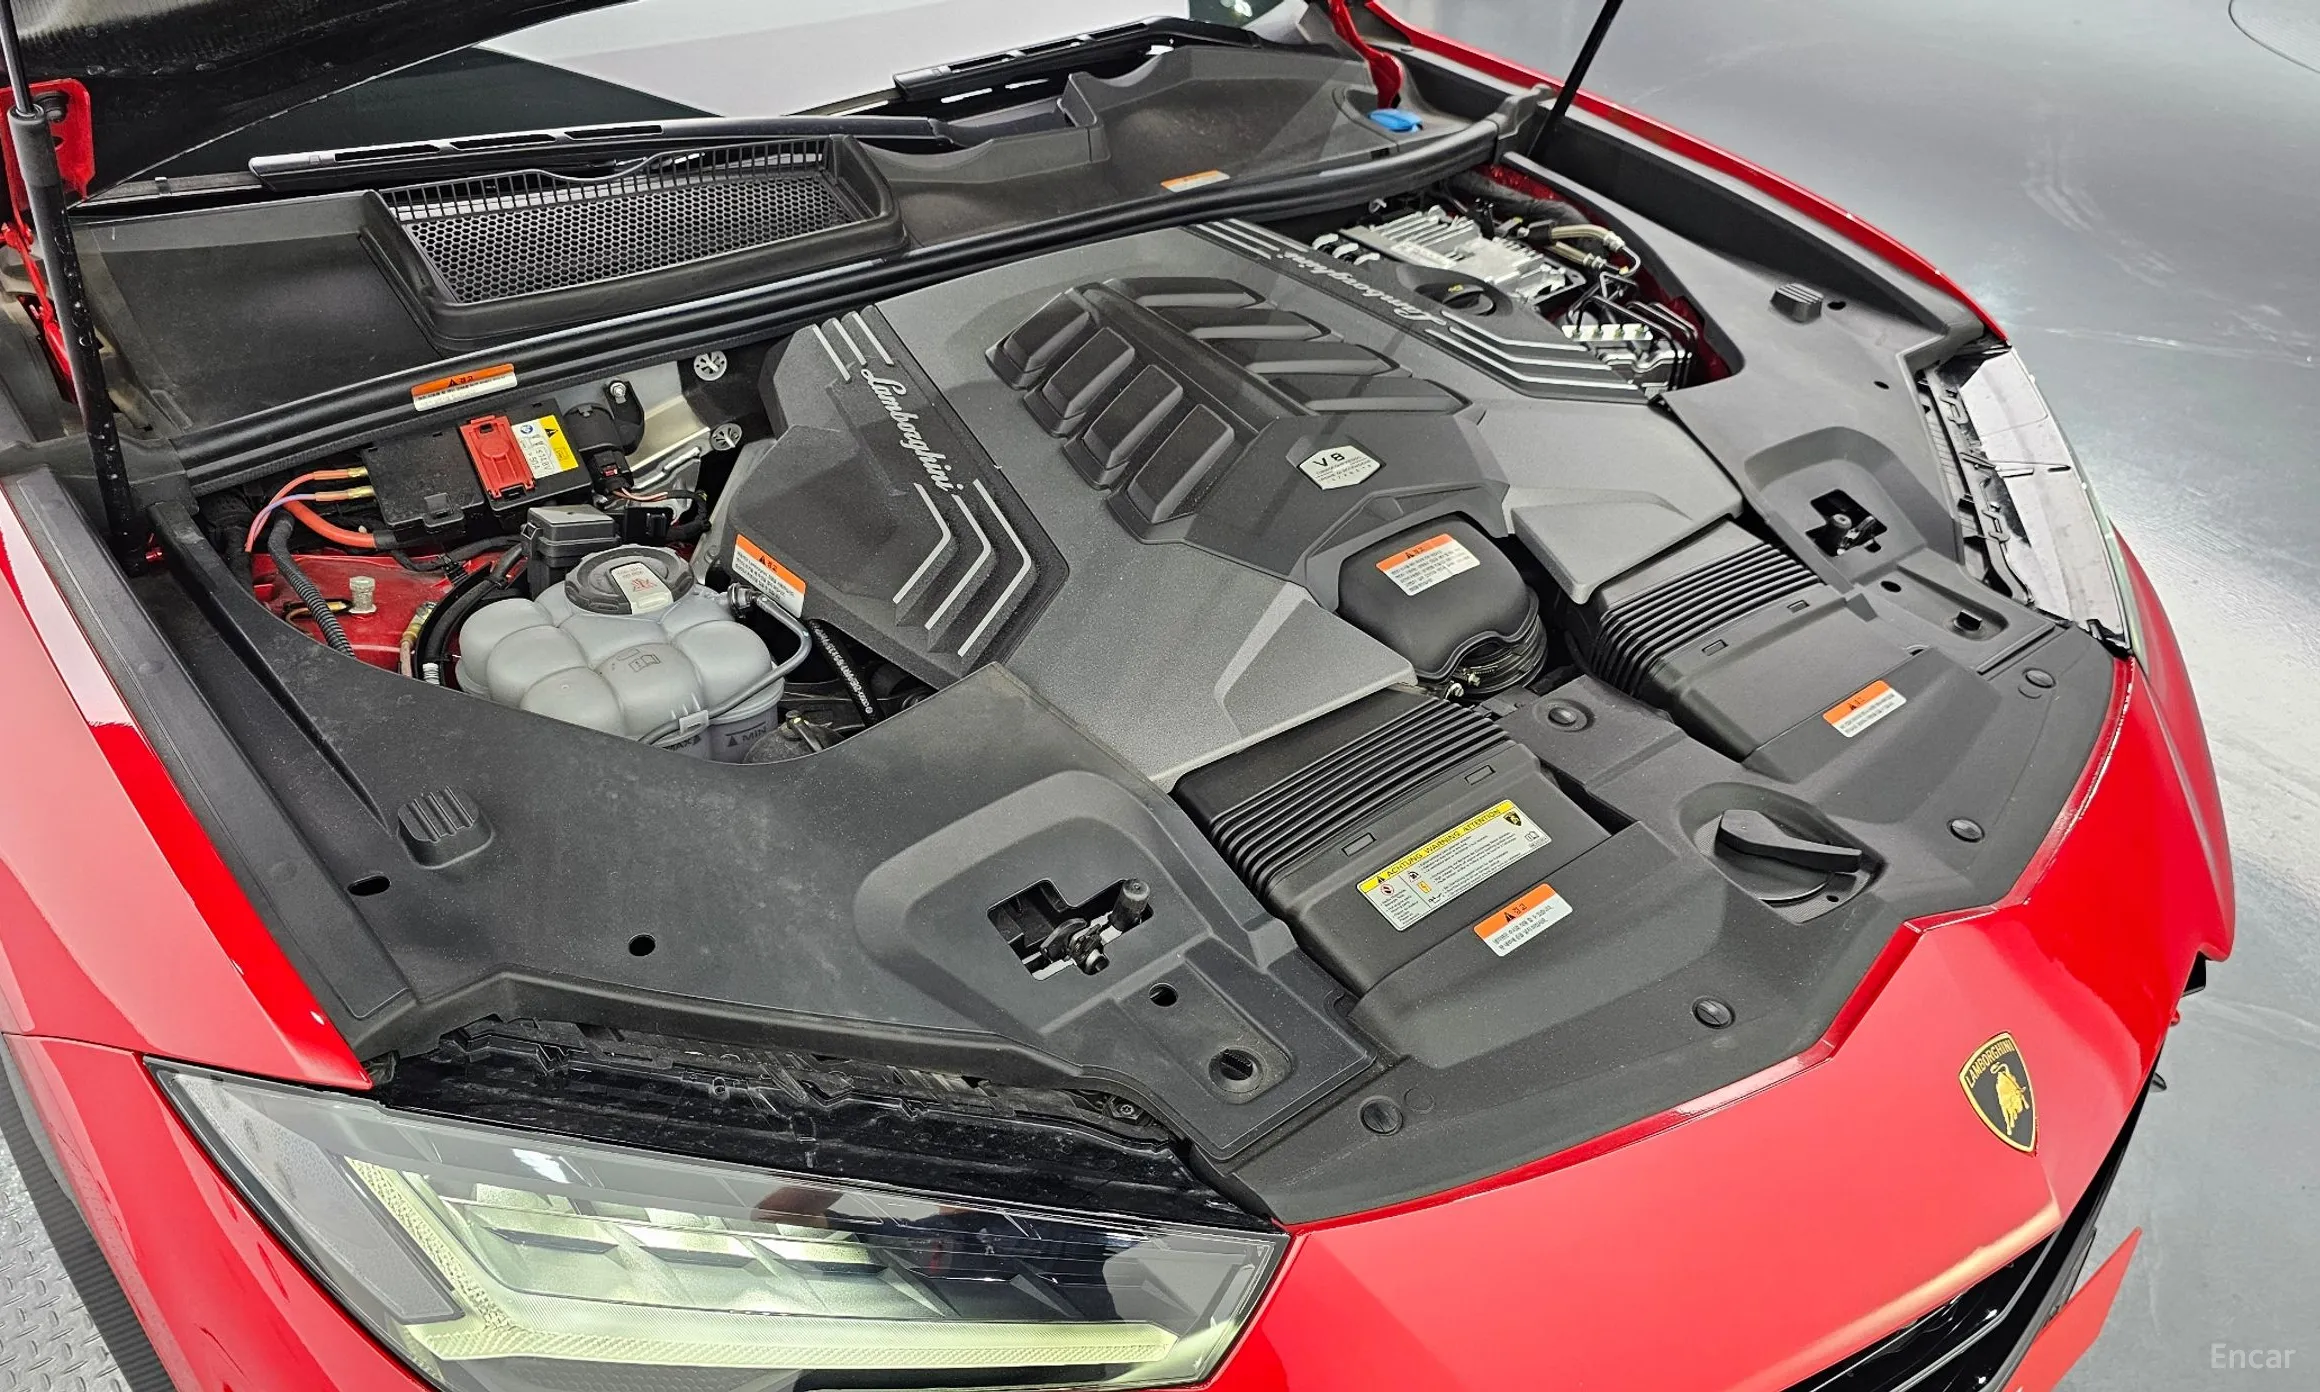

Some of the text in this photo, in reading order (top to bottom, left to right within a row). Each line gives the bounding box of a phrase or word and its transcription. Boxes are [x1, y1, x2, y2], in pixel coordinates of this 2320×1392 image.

[1277, 252, 1447, 326] Lamborghini
[861, 369, 964, 492] Lamborghini
[742, 726, 767, 742] MIN
[1386, 808, 1502, 878] ACHTUNG WARNING ATTENTION
[1965, 1039, 2016, 1089] LAMBORGHINI
